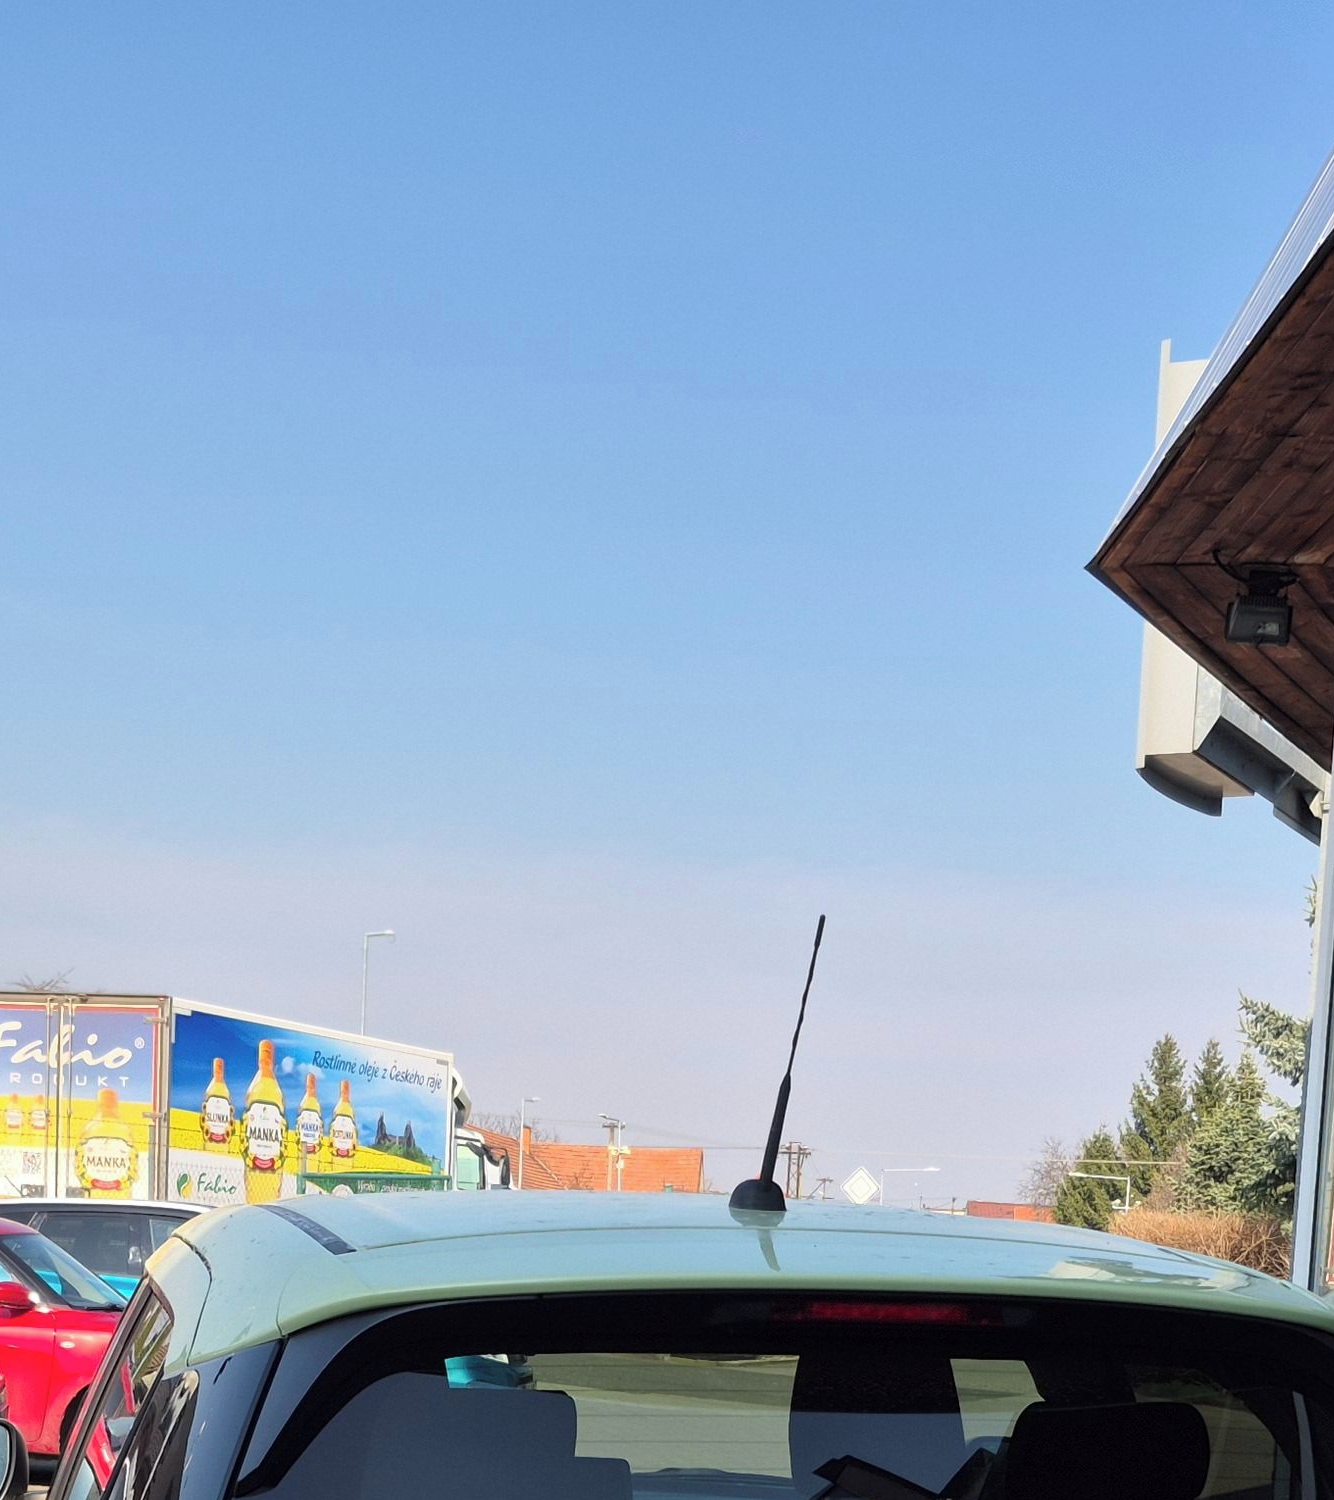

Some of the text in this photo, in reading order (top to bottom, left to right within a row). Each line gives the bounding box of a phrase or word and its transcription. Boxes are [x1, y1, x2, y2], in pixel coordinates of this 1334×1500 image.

[312, 1050, 443, 1094] Rostlinné oleje z Českého ráje
[249, 1127, 280, 1142] MANKA
[86, 1156, 127, 1169] MANKA
[196, 1171, 237, 1195] Fabio
